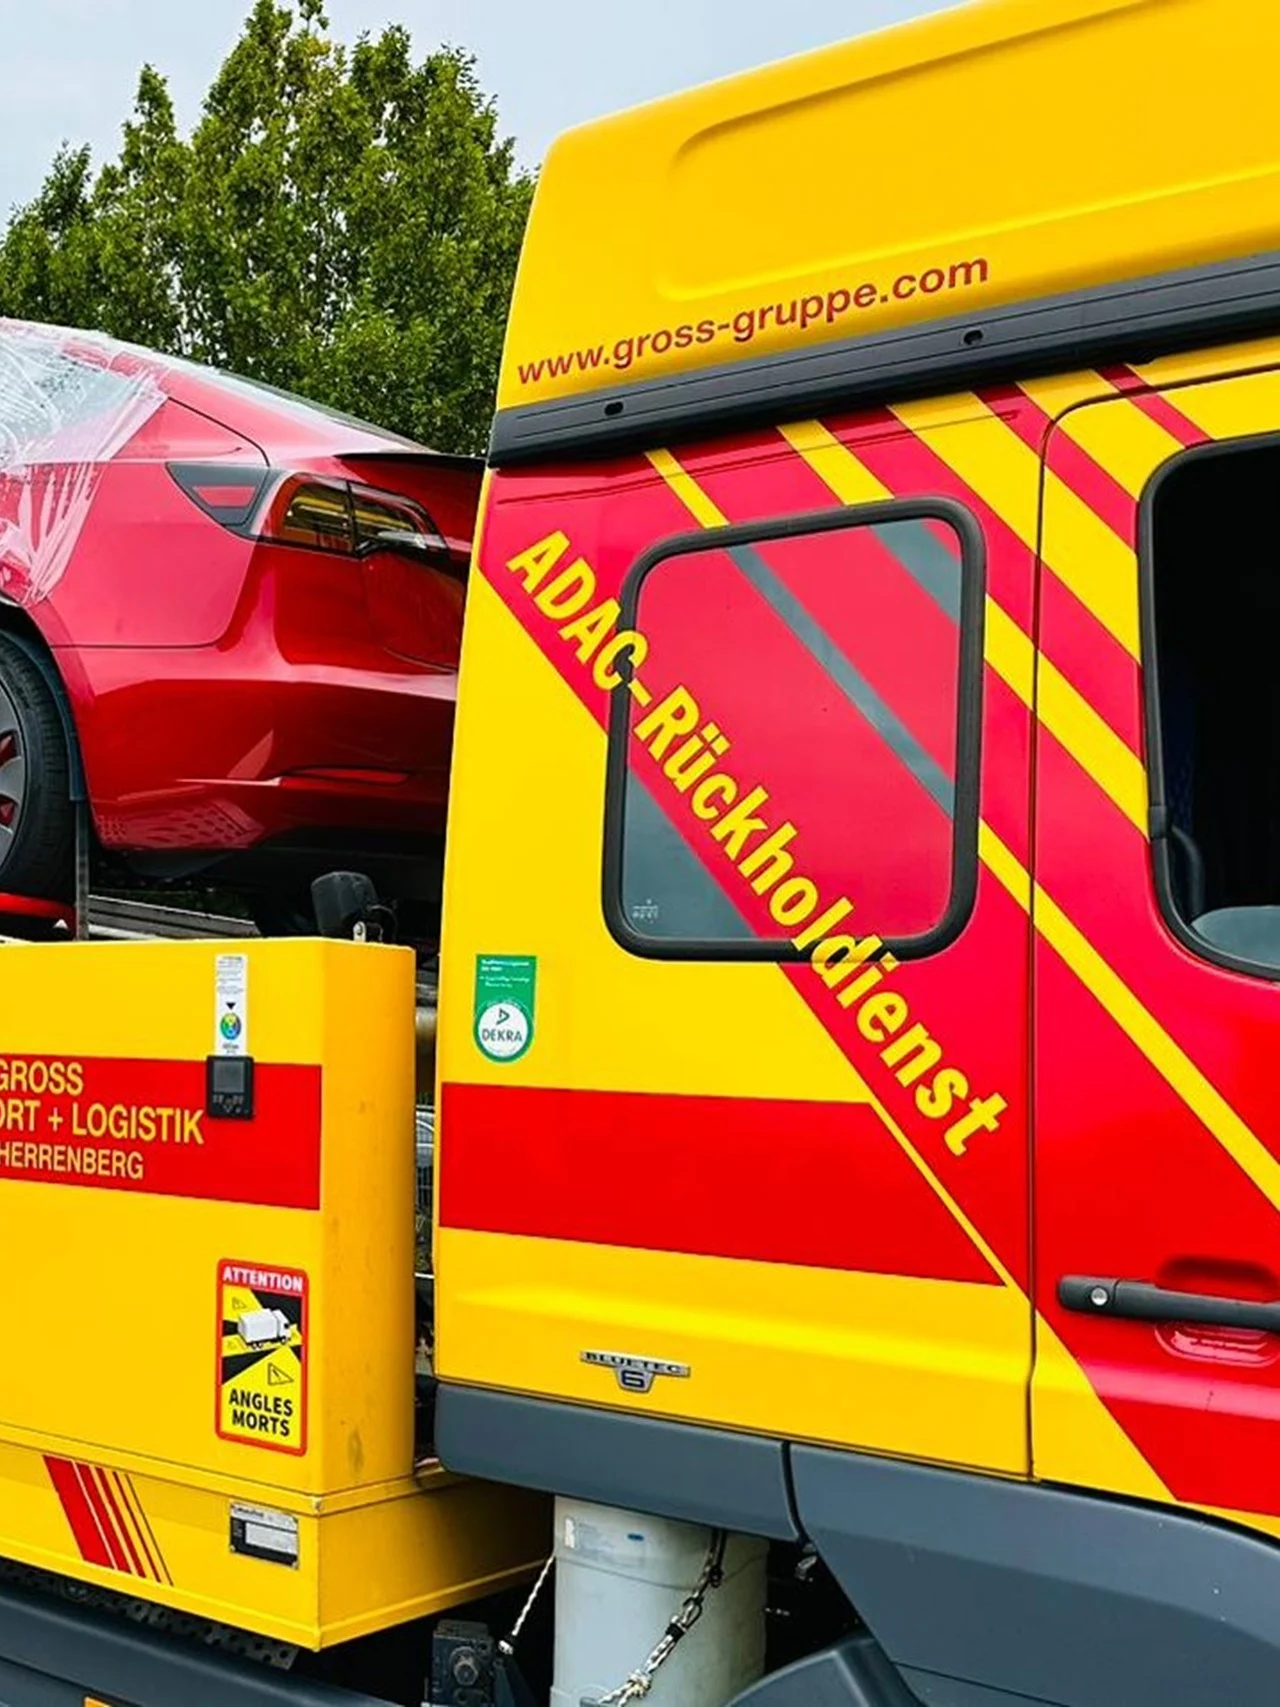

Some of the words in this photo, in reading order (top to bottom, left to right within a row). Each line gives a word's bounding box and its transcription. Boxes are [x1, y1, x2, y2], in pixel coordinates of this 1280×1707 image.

[517, 257, 989, 386] www.gross-gruppe.com
[507, 530, 1008, 1157] ADAC-Rückholdienst
[481, 1027, 523, 1043] DEKRA
[47, 1108, 64, 1132] +
[71, 1103, 204, 1145] LOGISTIK
[222, 1266, 304, 1292] ATTENTION
[585, 1351, 683, 1374] BLUETEC
[620, 1369, 646, 1389] 6
[228, 1388, 294, 1418] ANGLES
[231, 1408, 292, 1438] MORTS
